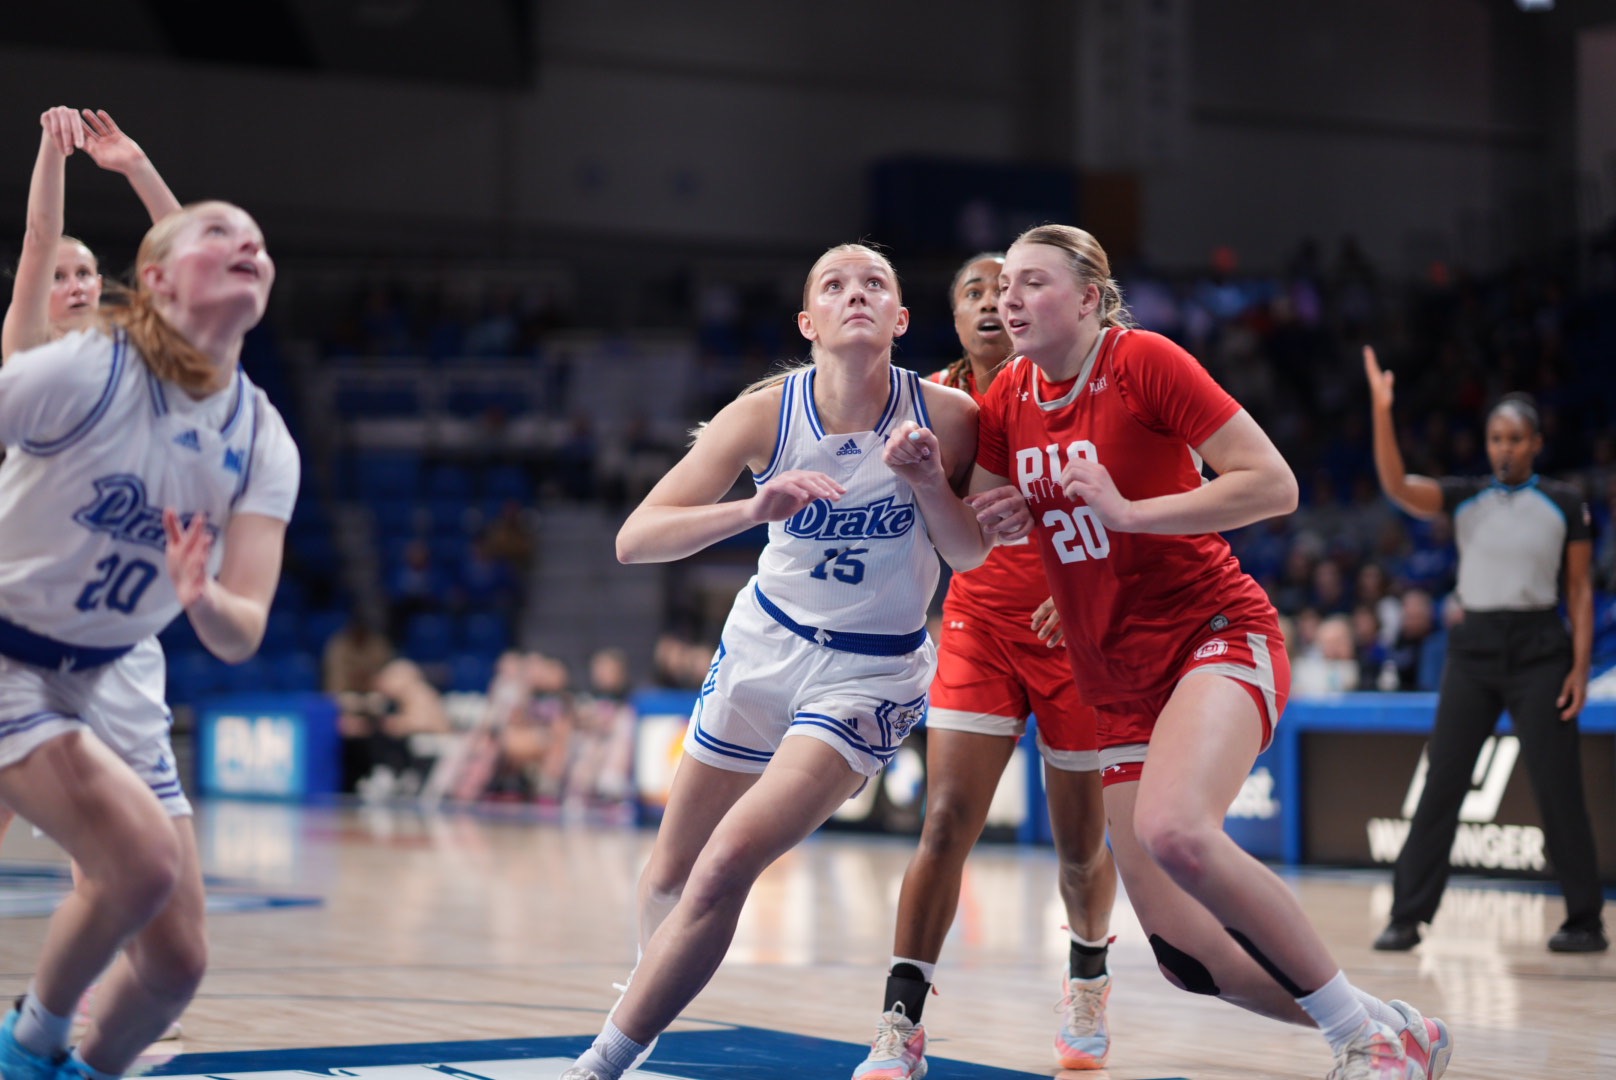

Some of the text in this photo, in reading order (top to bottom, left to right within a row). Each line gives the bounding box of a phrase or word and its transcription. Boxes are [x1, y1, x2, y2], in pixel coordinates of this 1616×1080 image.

[836, 448, 862, 456] adidas
[784, 495, 915, 540] Drake
[1042, 506, 1111, 564] 20
[75, 553, 159, 614] 20
[810, 548, 869, 585] 15
